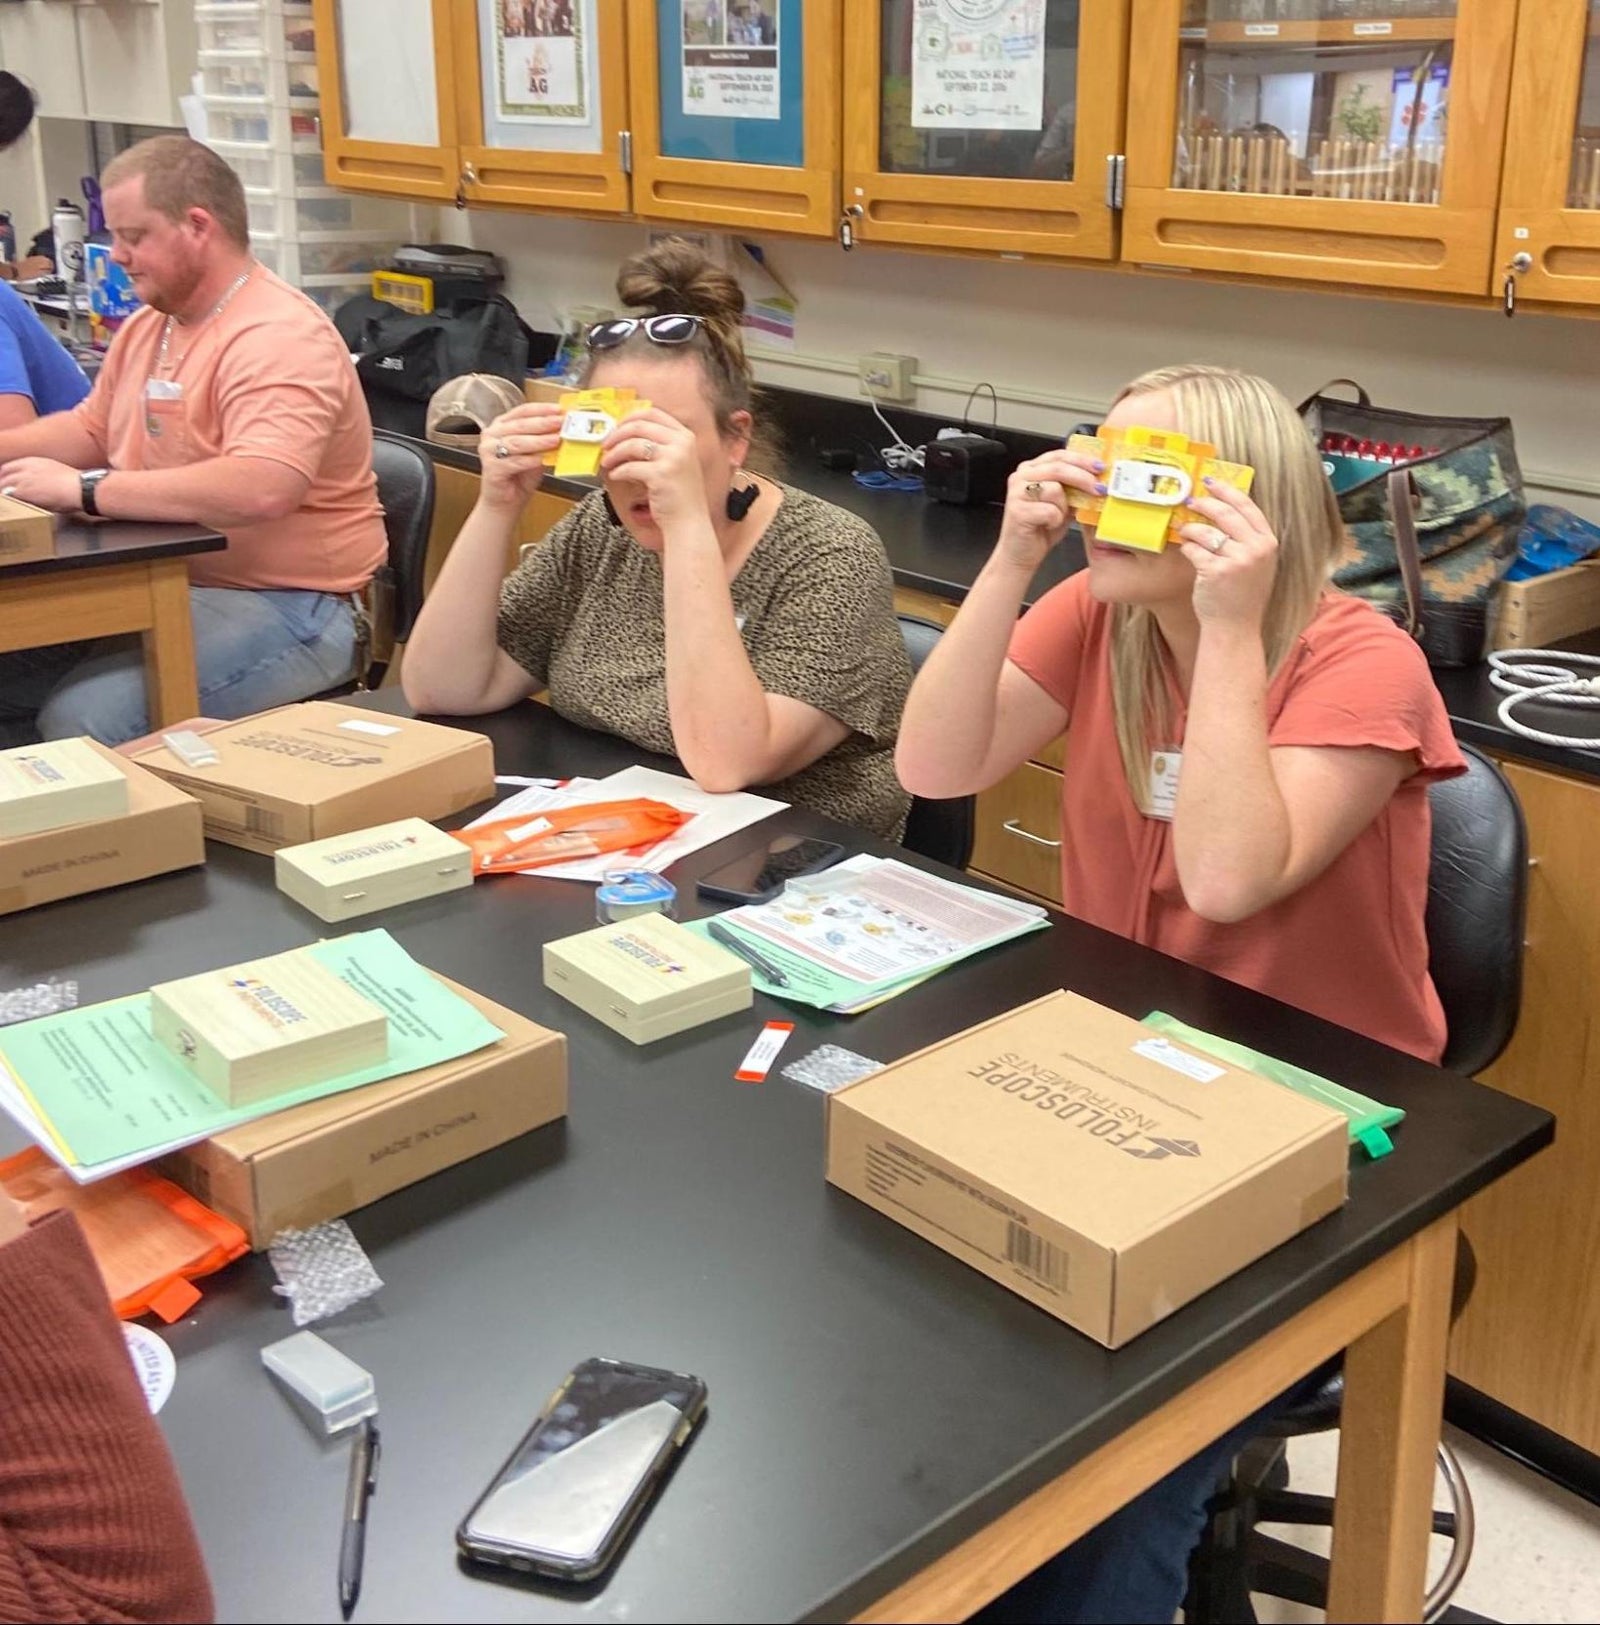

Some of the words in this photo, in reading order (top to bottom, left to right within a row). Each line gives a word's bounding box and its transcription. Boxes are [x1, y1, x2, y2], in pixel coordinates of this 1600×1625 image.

[529, 77, 548, 94] AG
[22, 862, 61, 878] MADE
[79, 849, 120, 864] CHINA
[967, 1060, 1141, 1147] FOLDSCOPE
[999, 1052, 1161, 1131] INSTRUMENTS
[369, 1136, 412, 1164] MADE
[416, 1130, 431, 1142] IN
[433, 1111, 477, 1136] CHINA
